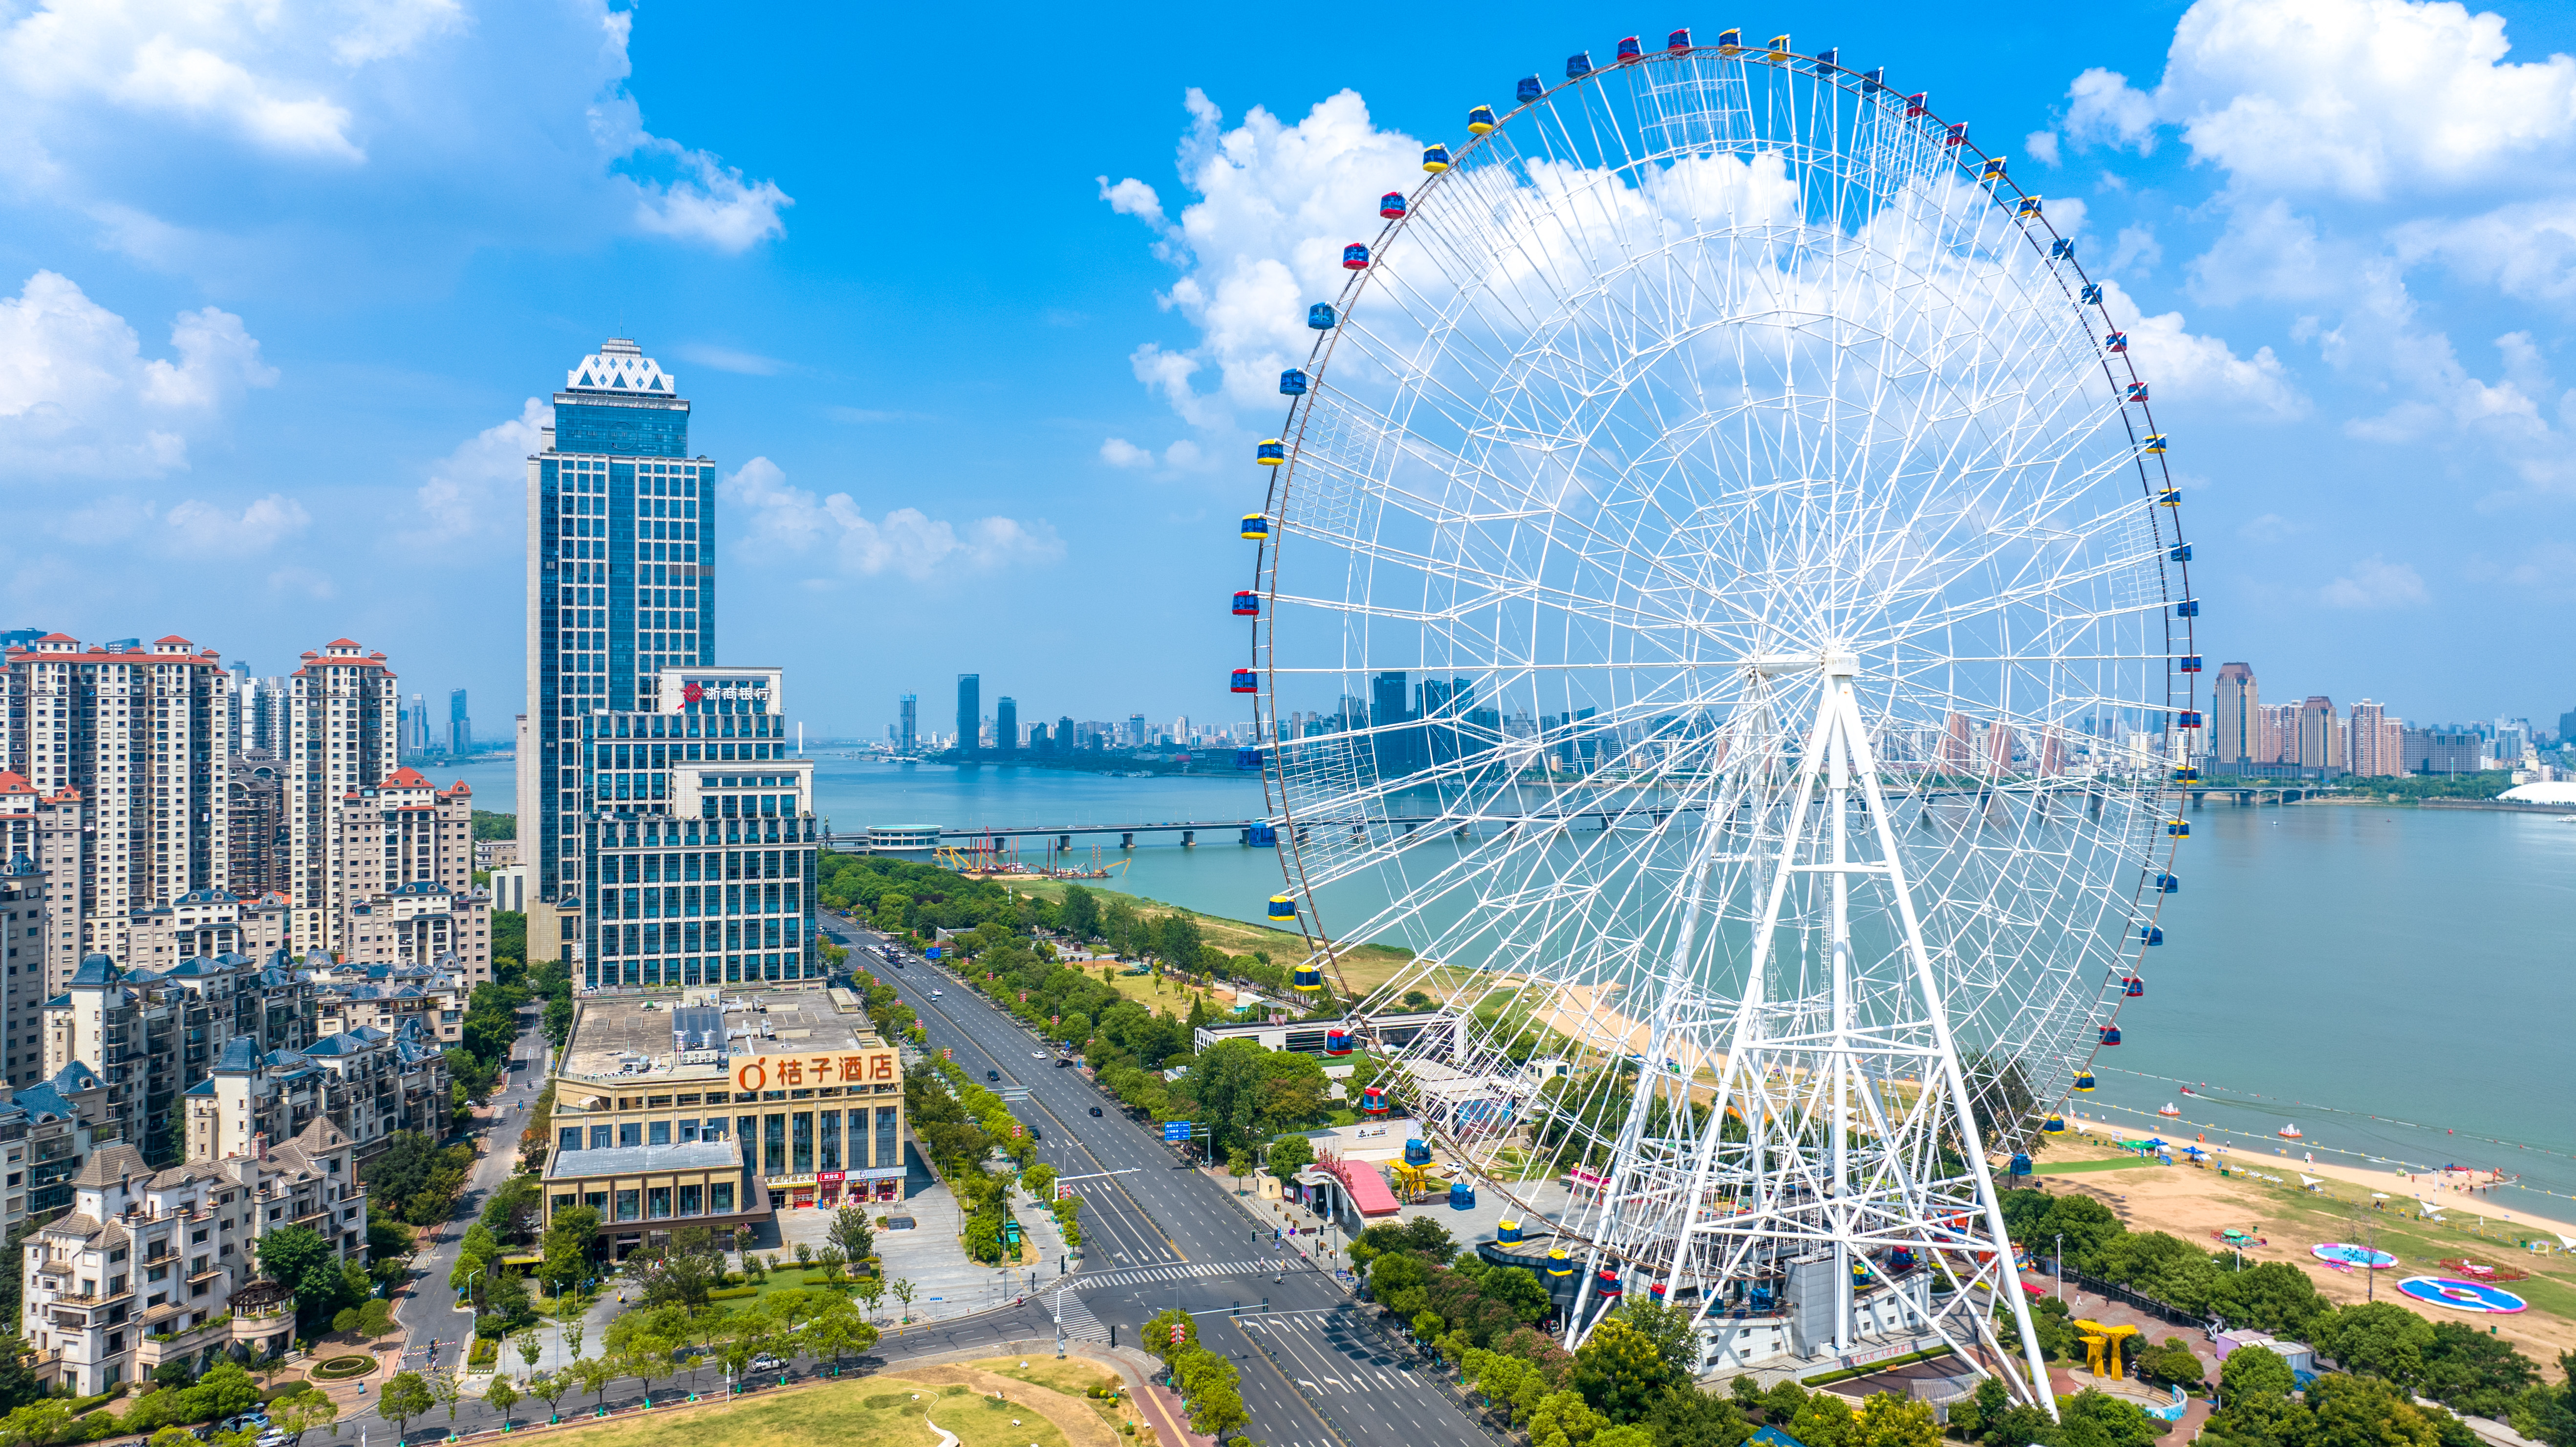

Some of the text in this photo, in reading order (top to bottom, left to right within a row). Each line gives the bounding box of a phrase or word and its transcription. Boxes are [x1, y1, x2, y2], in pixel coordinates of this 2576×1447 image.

[706, 686, 770, 701] 浙商银行
[777, 1054, 892, 1085] 桔子酒店
[1835, 1341, 1919, 1368] 江山就是人民 人民就是江山
